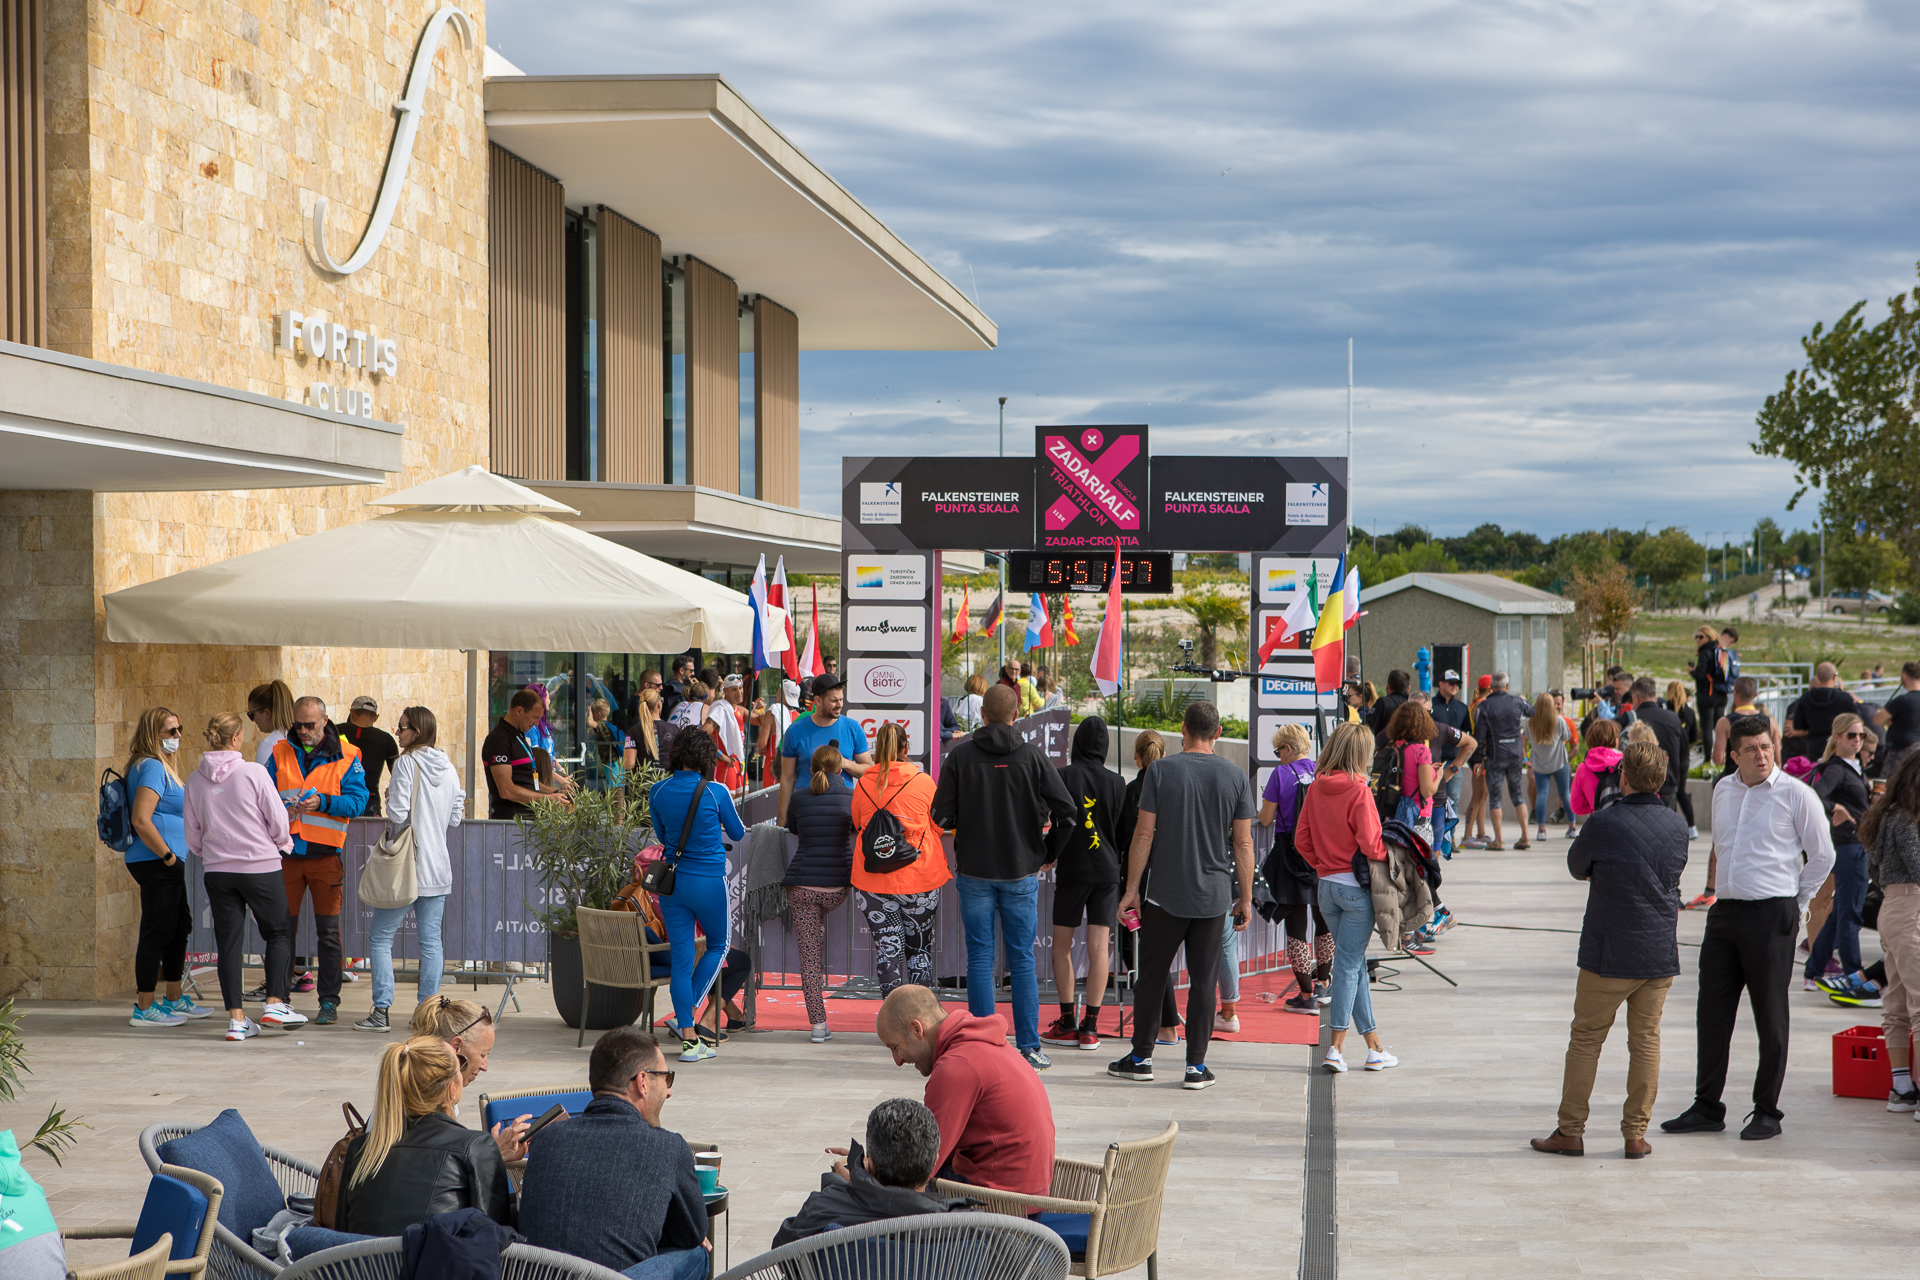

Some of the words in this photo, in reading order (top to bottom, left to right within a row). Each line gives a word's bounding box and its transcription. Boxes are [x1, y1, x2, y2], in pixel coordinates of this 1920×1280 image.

[281, 310, 397, 377] FORTIS
[310, 382, 372, 419] CLUB
[1049, 440, 1135, 522] ZADARHALF
[921, 492, 1020, 502] FALKENSTEINER
[1050, 467, 1108, 526] TRIATHLON
[1115, 478, 1137, 502] TRIXCLB
[1165, 492, 1264, 503] FALKENSTEINER
[935, 503, 976, 513] PUNTA
[978, 503, 1019, 513] SKALA
[1165, 503, 1207, 513] PUNTA
[1209, 503, 1250, 514] SKALA
[1266, 680, 1316, 691] DECATHL
[861, 718, 910, 738] GZ
[492, 755, 508, 763] 3GO
